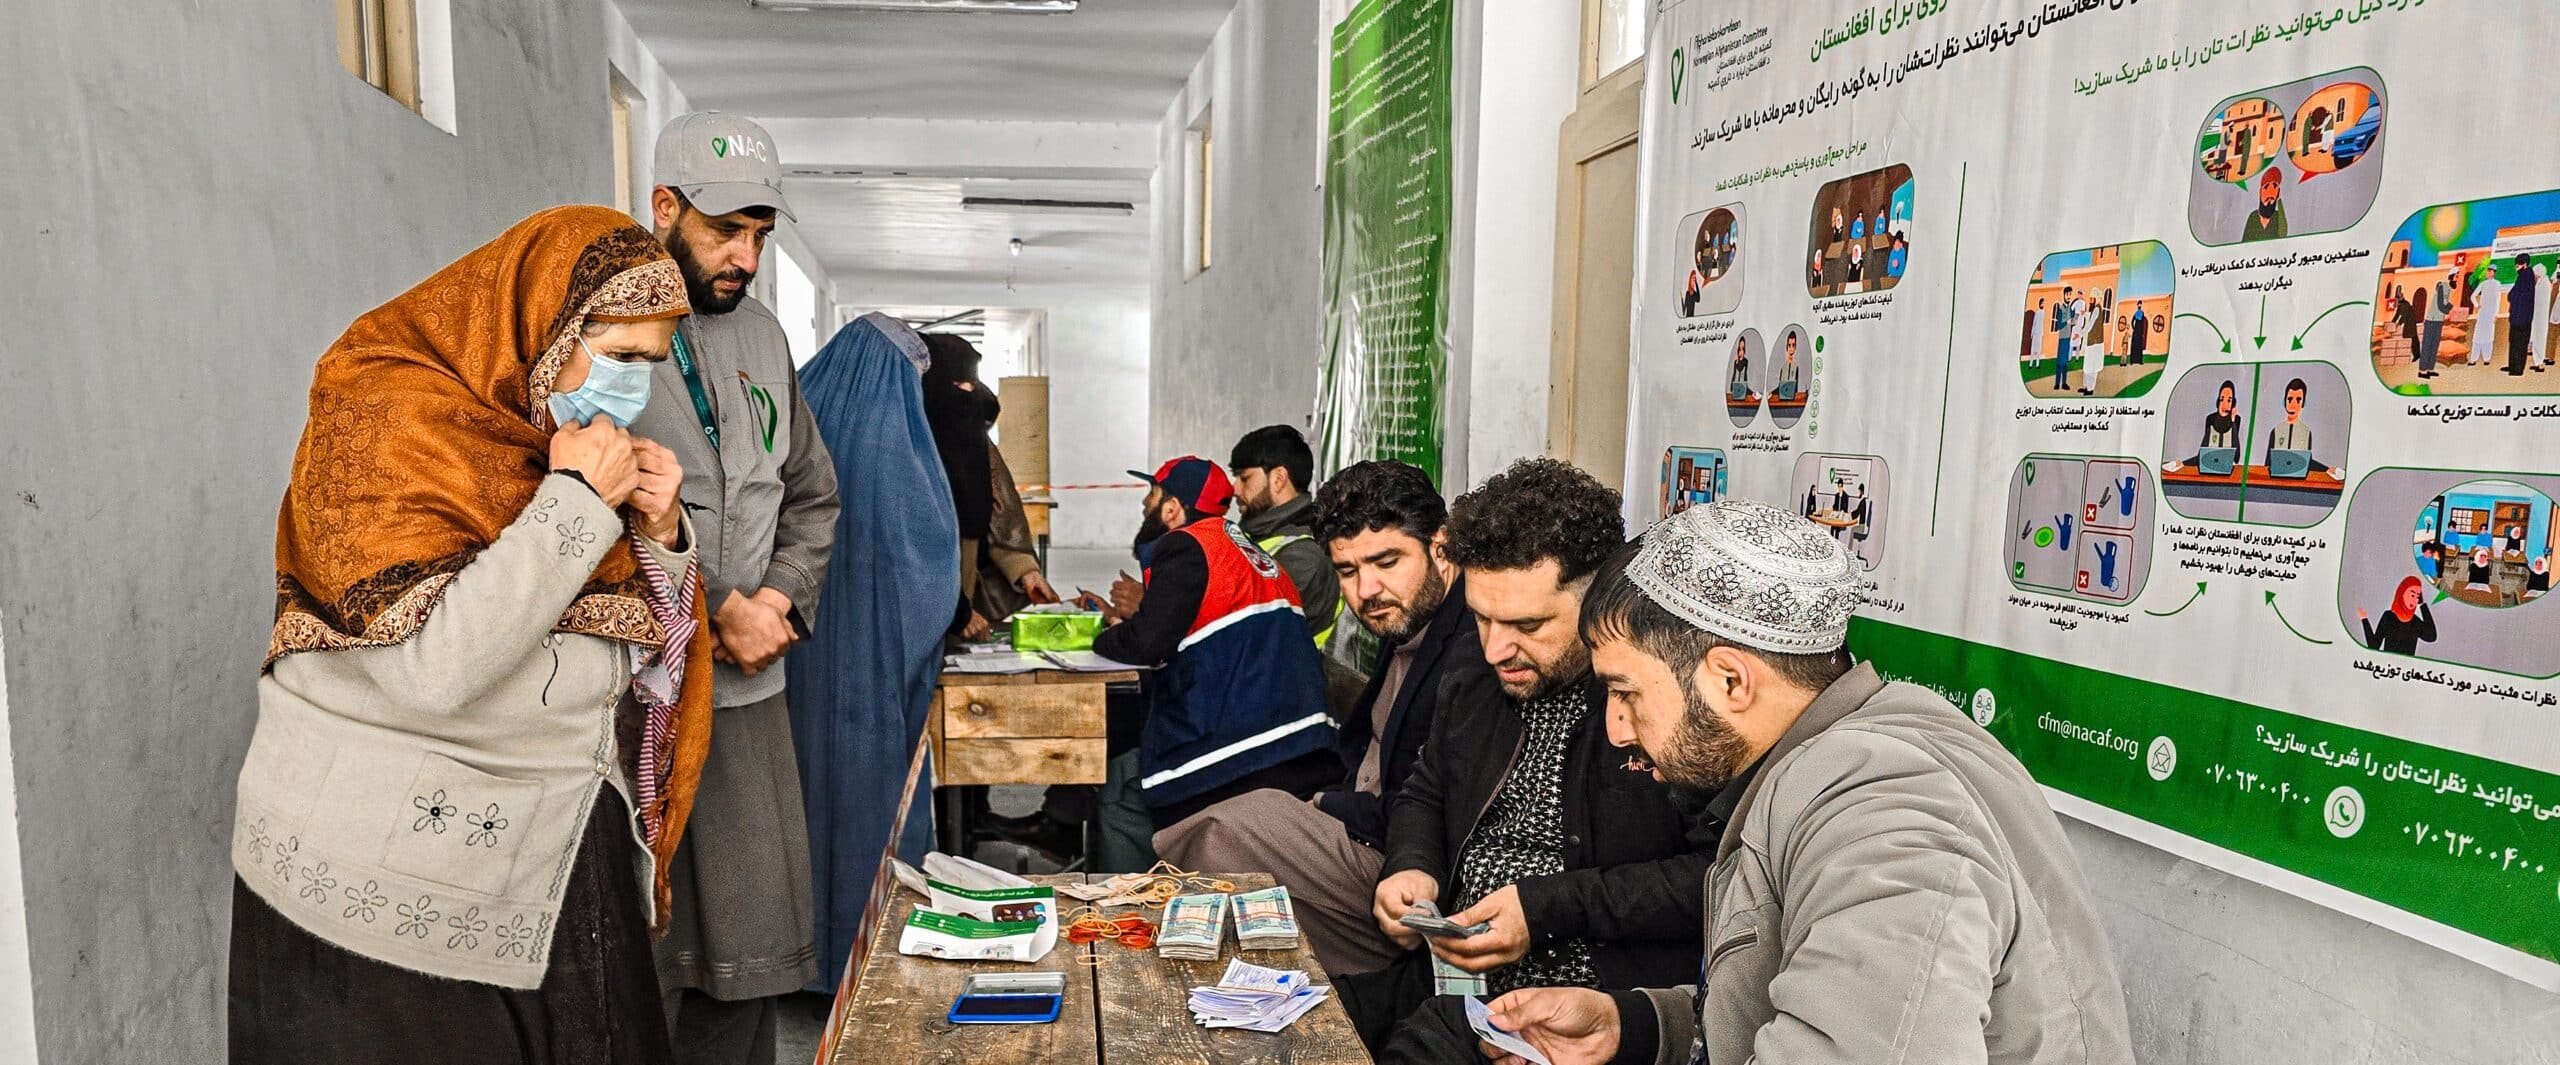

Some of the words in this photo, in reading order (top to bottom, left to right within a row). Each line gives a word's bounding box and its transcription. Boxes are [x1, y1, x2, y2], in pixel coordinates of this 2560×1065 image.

[2028, 0, 2104, 38] فغانستان
[1742, 27, 1768, 45] Committee
[1811, 7, 1875, 62] افغانستان
[2226, 24, 2270, 52] نظرات
[2185, 47, 2196, 67] را
[2200, 38, 2223, 64] تان
[2157, 55, 2167, 70] ما
[2171, 51, 2181, 71] با
[1884, 62, 1894, 86] را
[2116, 58, 2152, 84] شریک
[1842, 66, 1865, 98] گونه
[1868, 72, 1880, 91] به
[1807, 82, 1839, 113] رایگان
[1762, 100, 1796, 124] محرمانه
[1798, 99, 1804, 117] و
[1717, 115, 1741, 142] شریک
[1745, 114, 1751, 130] ما
[1754, 110, 1760, 131] با
[728, 135, 766, 162] NAC
[2227, 259, 2244, 271] کمک
[2246, 258, 2256, 267] که
[2299, 254, 2322, 266] مجبور
[2264, 276, 2293, 291] دیگران
[2116, 406, 2140, 415] استفاده
[2442, 406, 2472, 423] توزیع
[2474, 405, 2511, 417] قسمت
[2513, 408, 2527, 420] در
[2530, 404, 2560, 417] کلات
[2162, 524, 2169, 535] را
[2170, 524, 2183, 534] شما
[2186, 527, 2207, 539] نظرات
[2208, 531, 2241, 541] افغانستان
[2243, 532, 2259, 545] برای
[2283, 537, 2306, 548] کمیته
[2307, 540, 2317, 550] در
[2319, 539, 2326, 549] ما
[2206, 545, 2232, 556] بتوانیم
[2233, 546, 2239, 555] تا
[2226, 562, 2233, 574] را
[2234, 564, 2257, 577] خویش
[2447, 677, 2471, 692] مورد
[2474, 682, 2488, 695] در
[2490, 683, 2519, 700] مثبت
[2522, 690, 2558, 707] نظرات
[2038, 711, 2139, 760] cfm@nacaf.org
[2310, 741, 2360, 768] شریک
[2364, 752, 2378, 776] را
